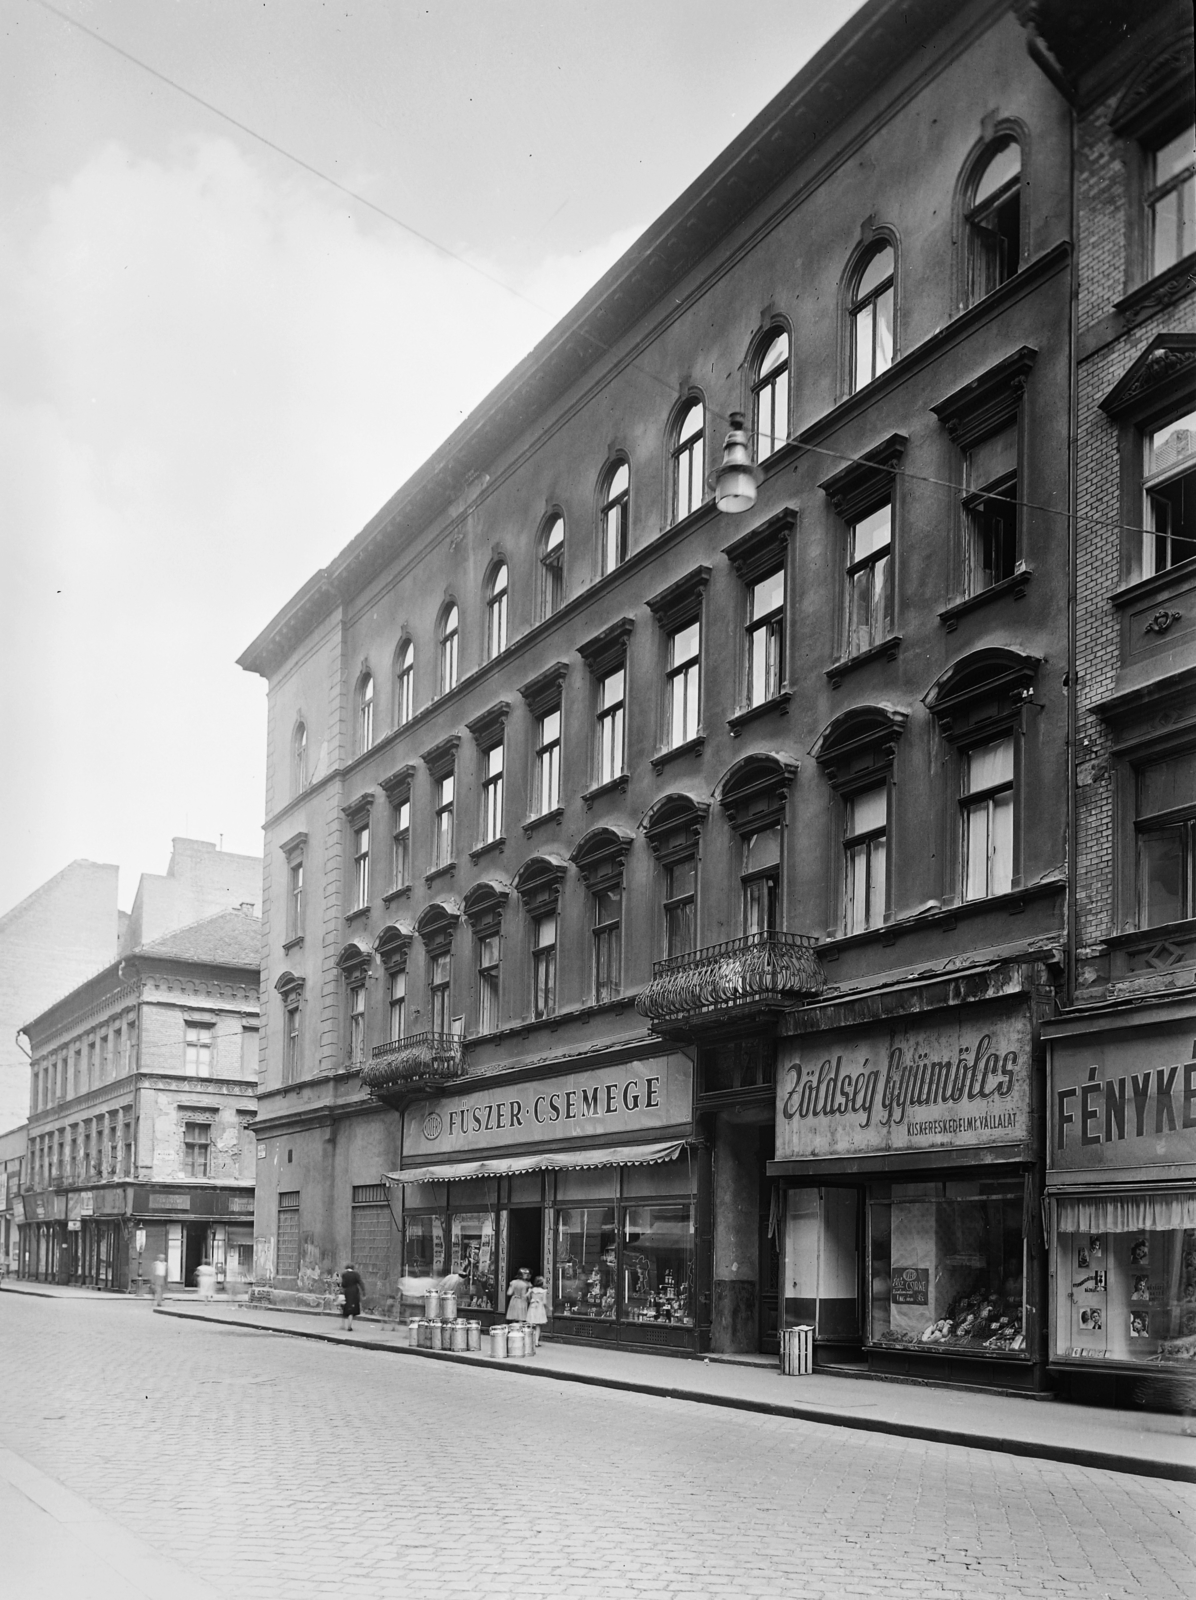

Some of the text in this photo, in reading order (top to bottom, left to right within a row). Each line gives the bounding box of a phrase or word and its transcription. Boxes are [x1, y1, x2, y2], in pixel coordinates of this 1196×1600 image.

[533, 1076, 661, 1124] CSEMEGE
[783, 1033, 1018, 1129] Zöldség Gyümölcs
